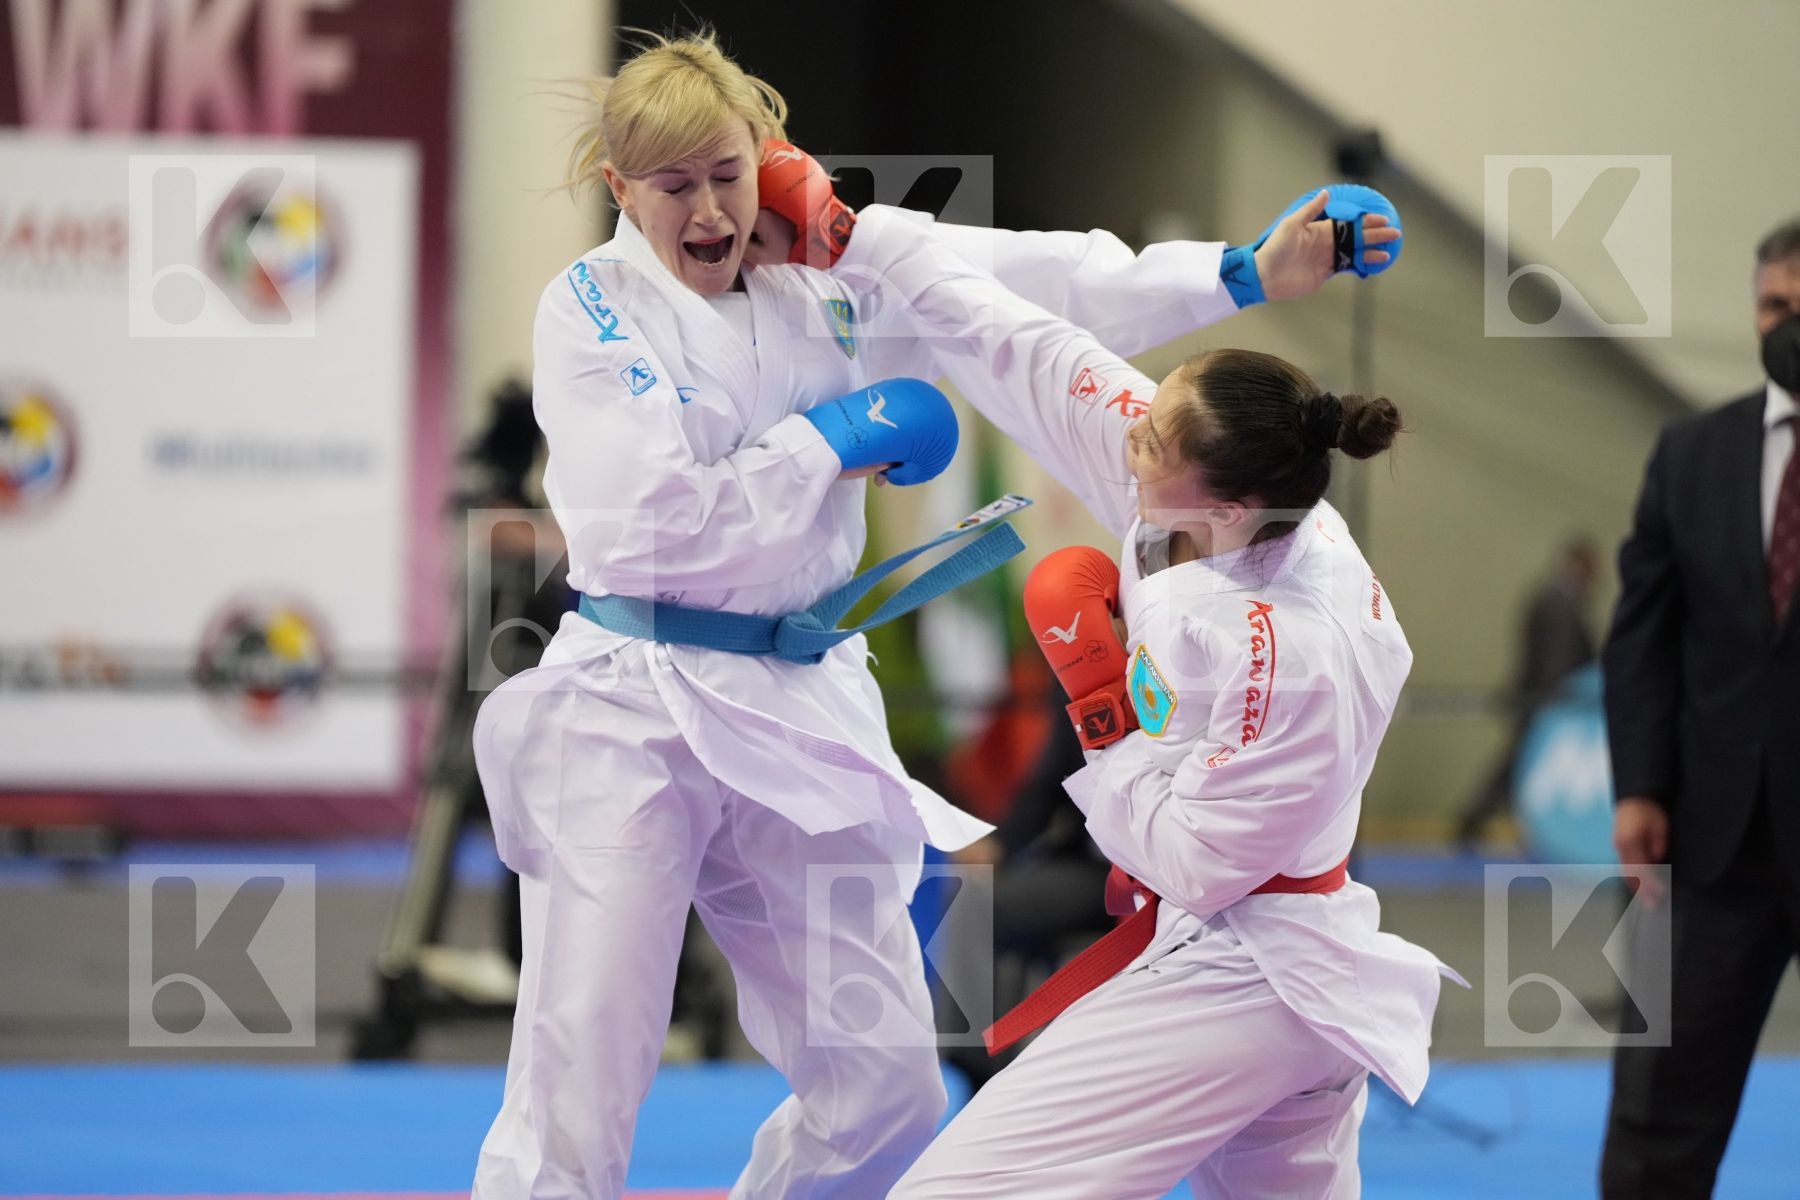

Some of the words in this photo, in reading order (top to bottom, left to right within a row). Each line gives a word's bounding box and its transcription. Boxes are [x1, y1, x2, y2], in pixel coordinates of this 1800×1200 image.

[8, 0, 354, 140] WKF
[1371, 582, 1381, 621] WORLD
[1140, 649, 1174, 704] KAZAKHSTAN
[1240, 599, 1275, 747] Arawaza
